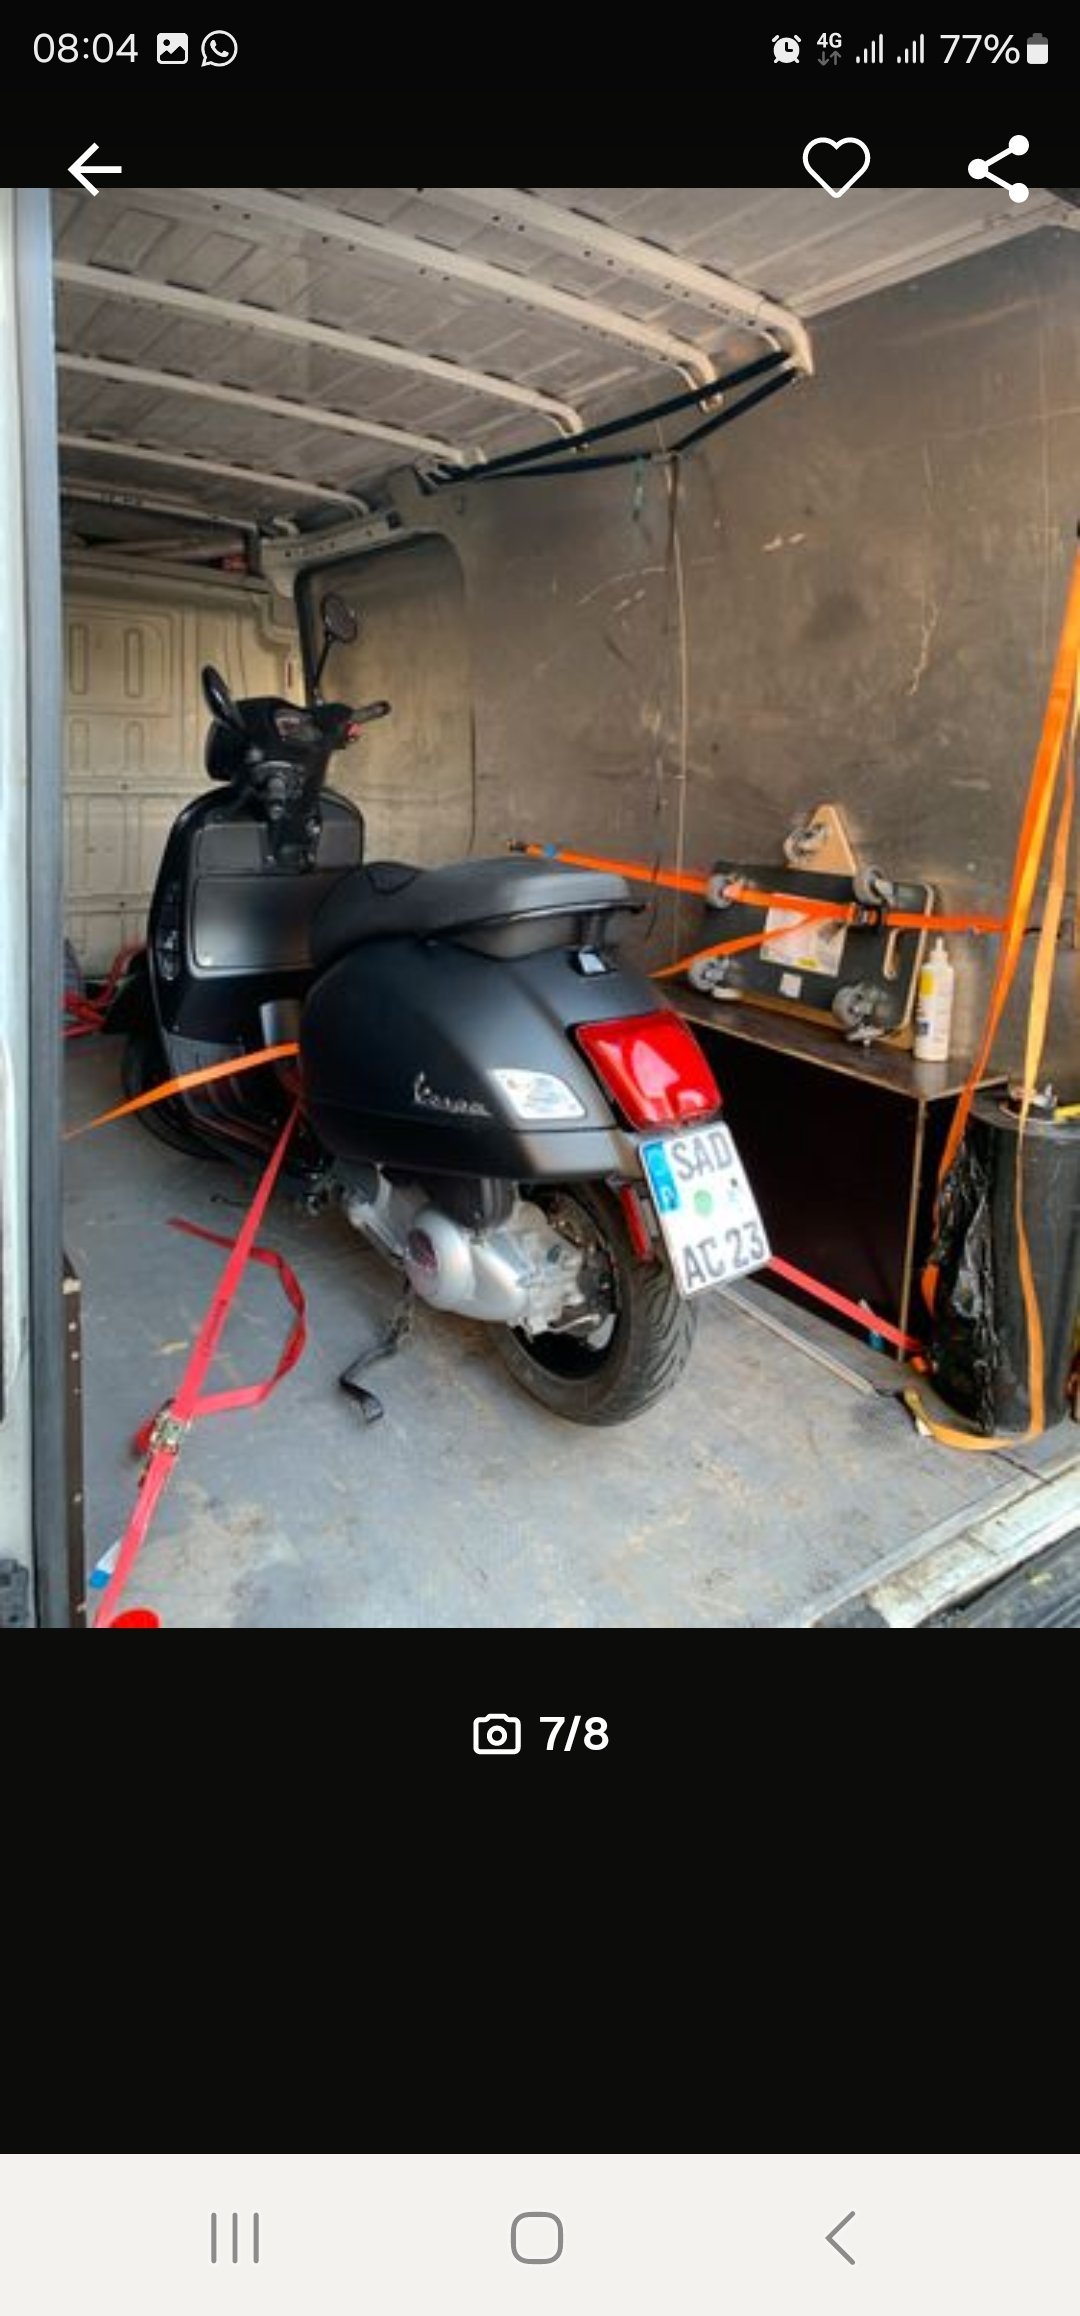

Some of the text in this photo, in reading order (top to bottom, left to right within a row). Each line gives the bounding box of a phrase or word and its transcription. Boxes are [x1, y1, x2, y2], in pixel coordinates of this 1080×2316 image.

[671, 1131, 734, 1181] SAD
[682, 1220, 765, 1290] AC 23
